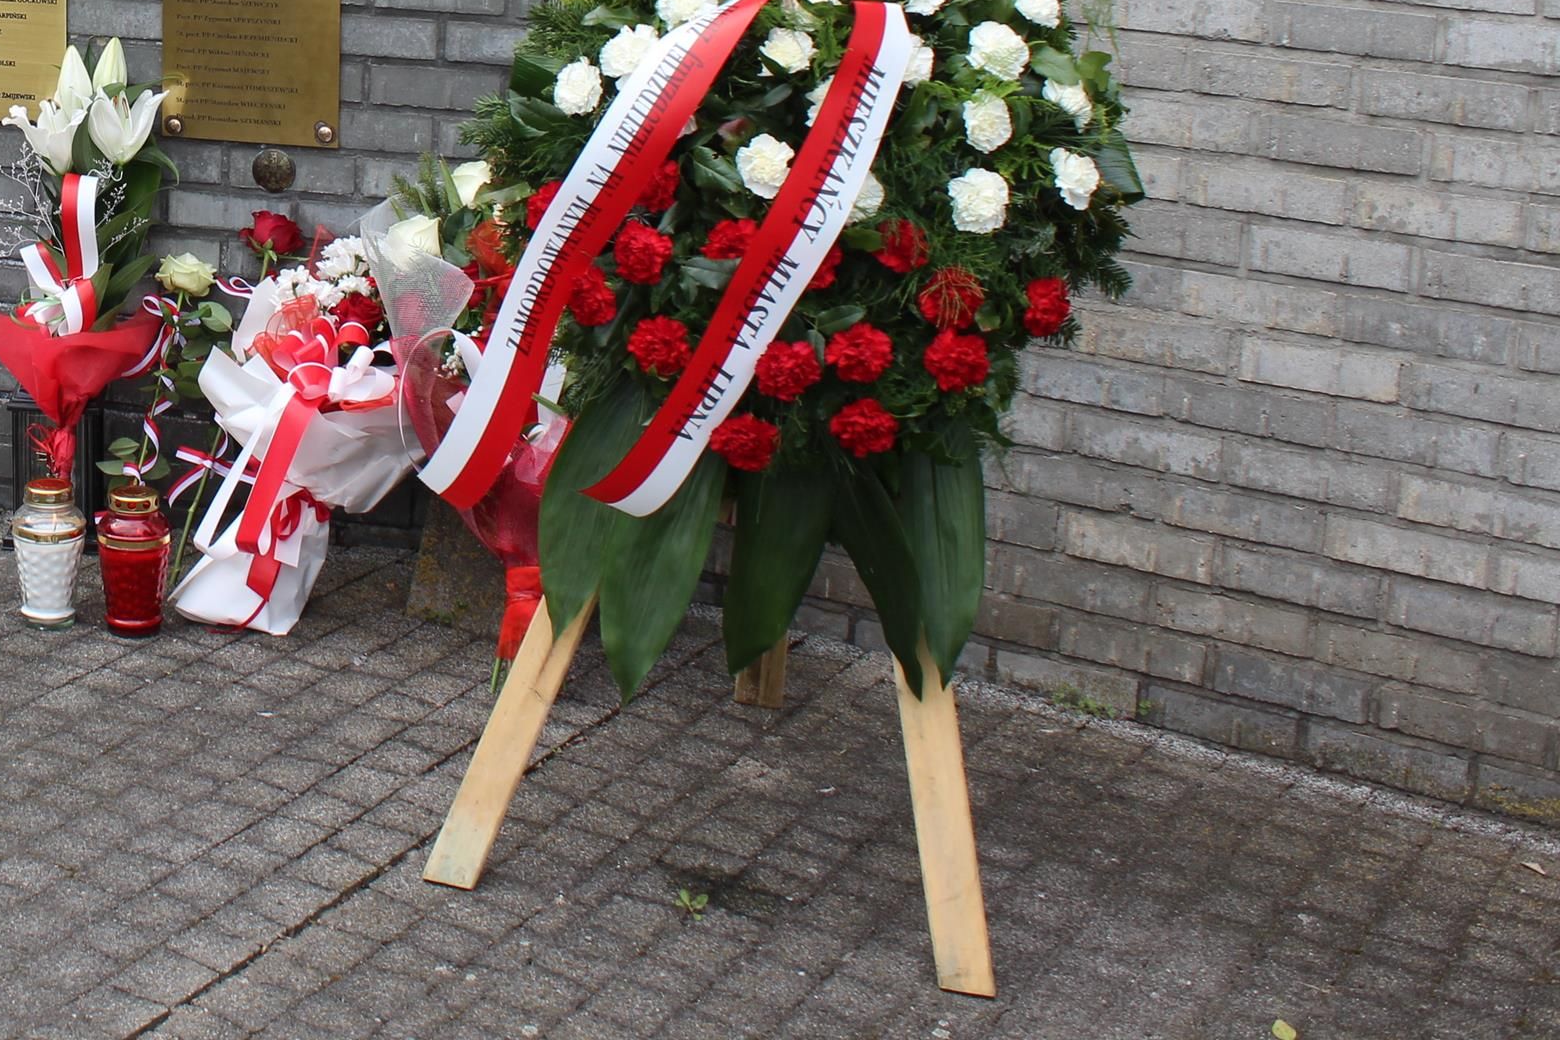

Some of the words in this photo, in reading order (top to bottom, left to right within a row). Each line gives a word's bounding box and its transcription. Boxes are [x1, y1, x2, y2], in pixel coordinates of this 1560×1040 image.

[506, 194, 601, 357] ZAMORDOWANYM
[587, 162, 623, 199] NA
[608, 42, 703, 166] NIELUDZKIEJ
[790, 54, 886, 245] MIESZKAŃCY
[726, 247, 799, 350] MIASTA
[670, 361, 735, 442] LIPNA
